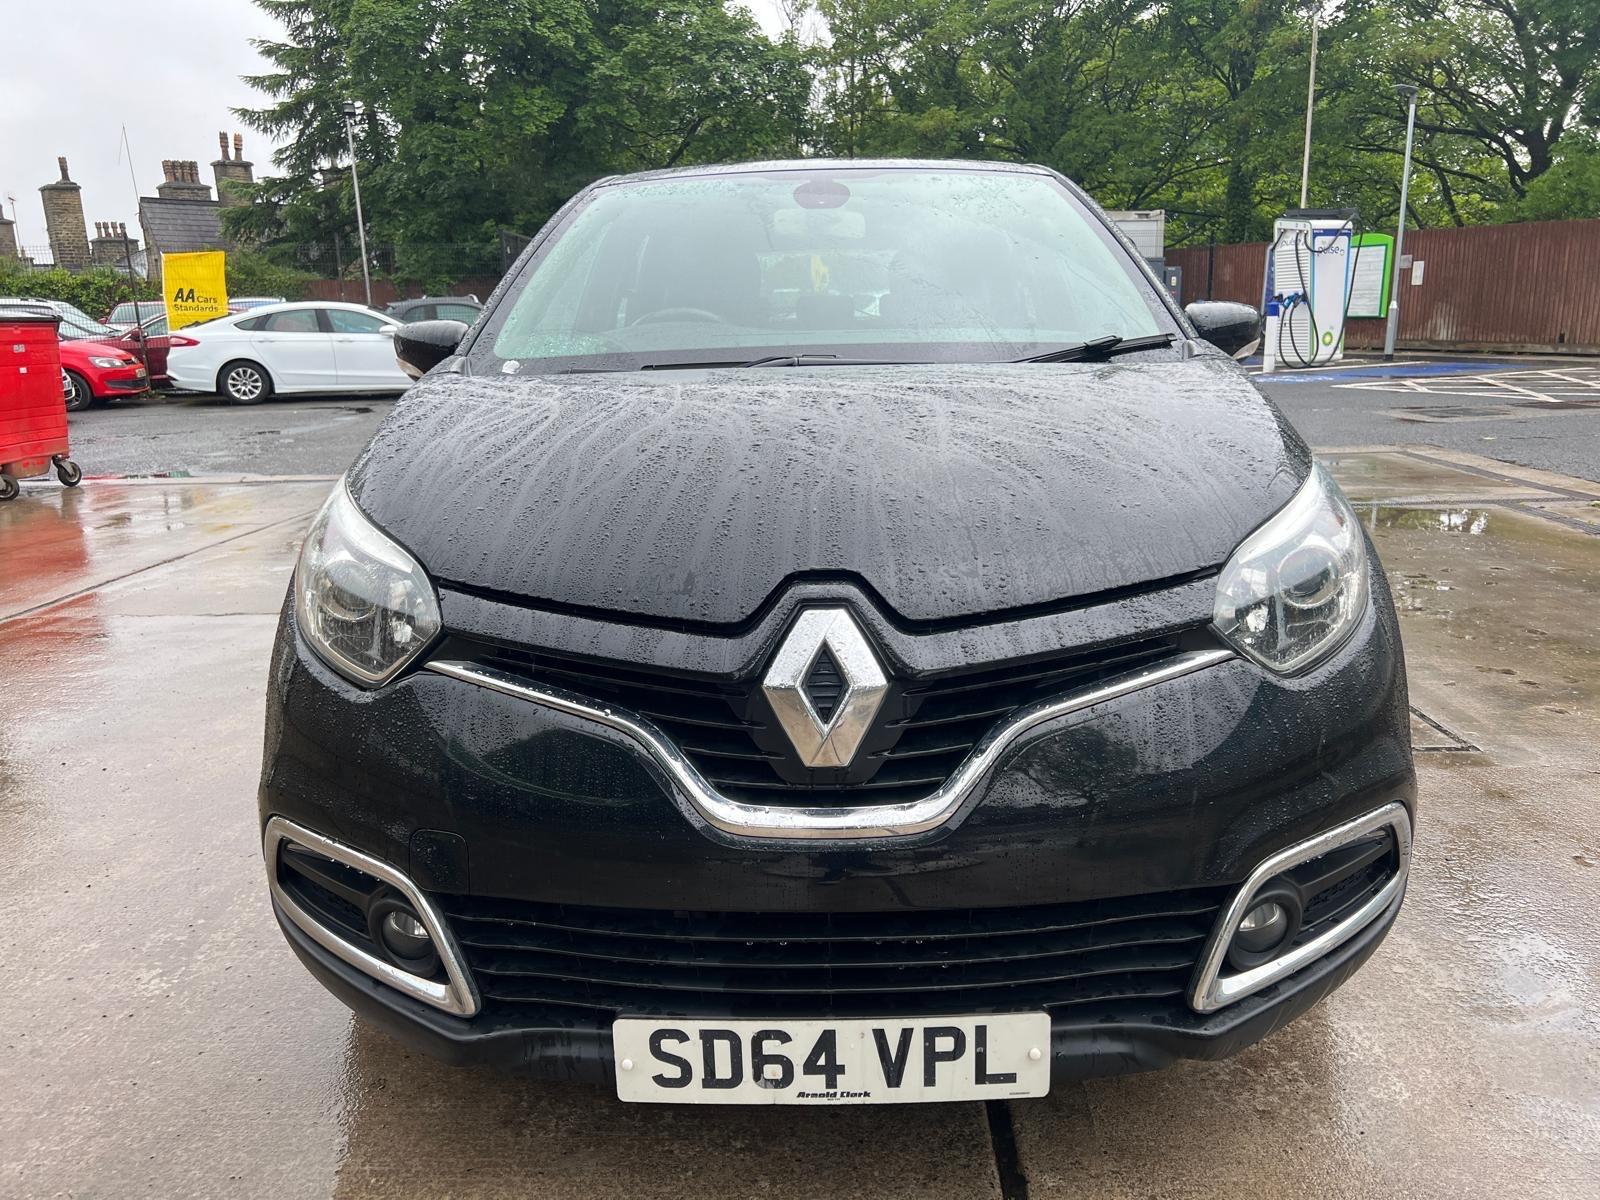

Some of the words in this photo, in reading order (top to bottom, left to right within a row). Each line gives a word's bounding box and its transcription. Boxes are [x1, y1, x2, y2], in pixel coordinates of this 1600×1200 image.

[174, 288, 196, 303] AA
[197, 296, 218, 304] Cars
[174, 303, 219, 312] Standards
[648, 1028, 846, 1090] SD64
[872, 1025, 1017, 1089] VPL
